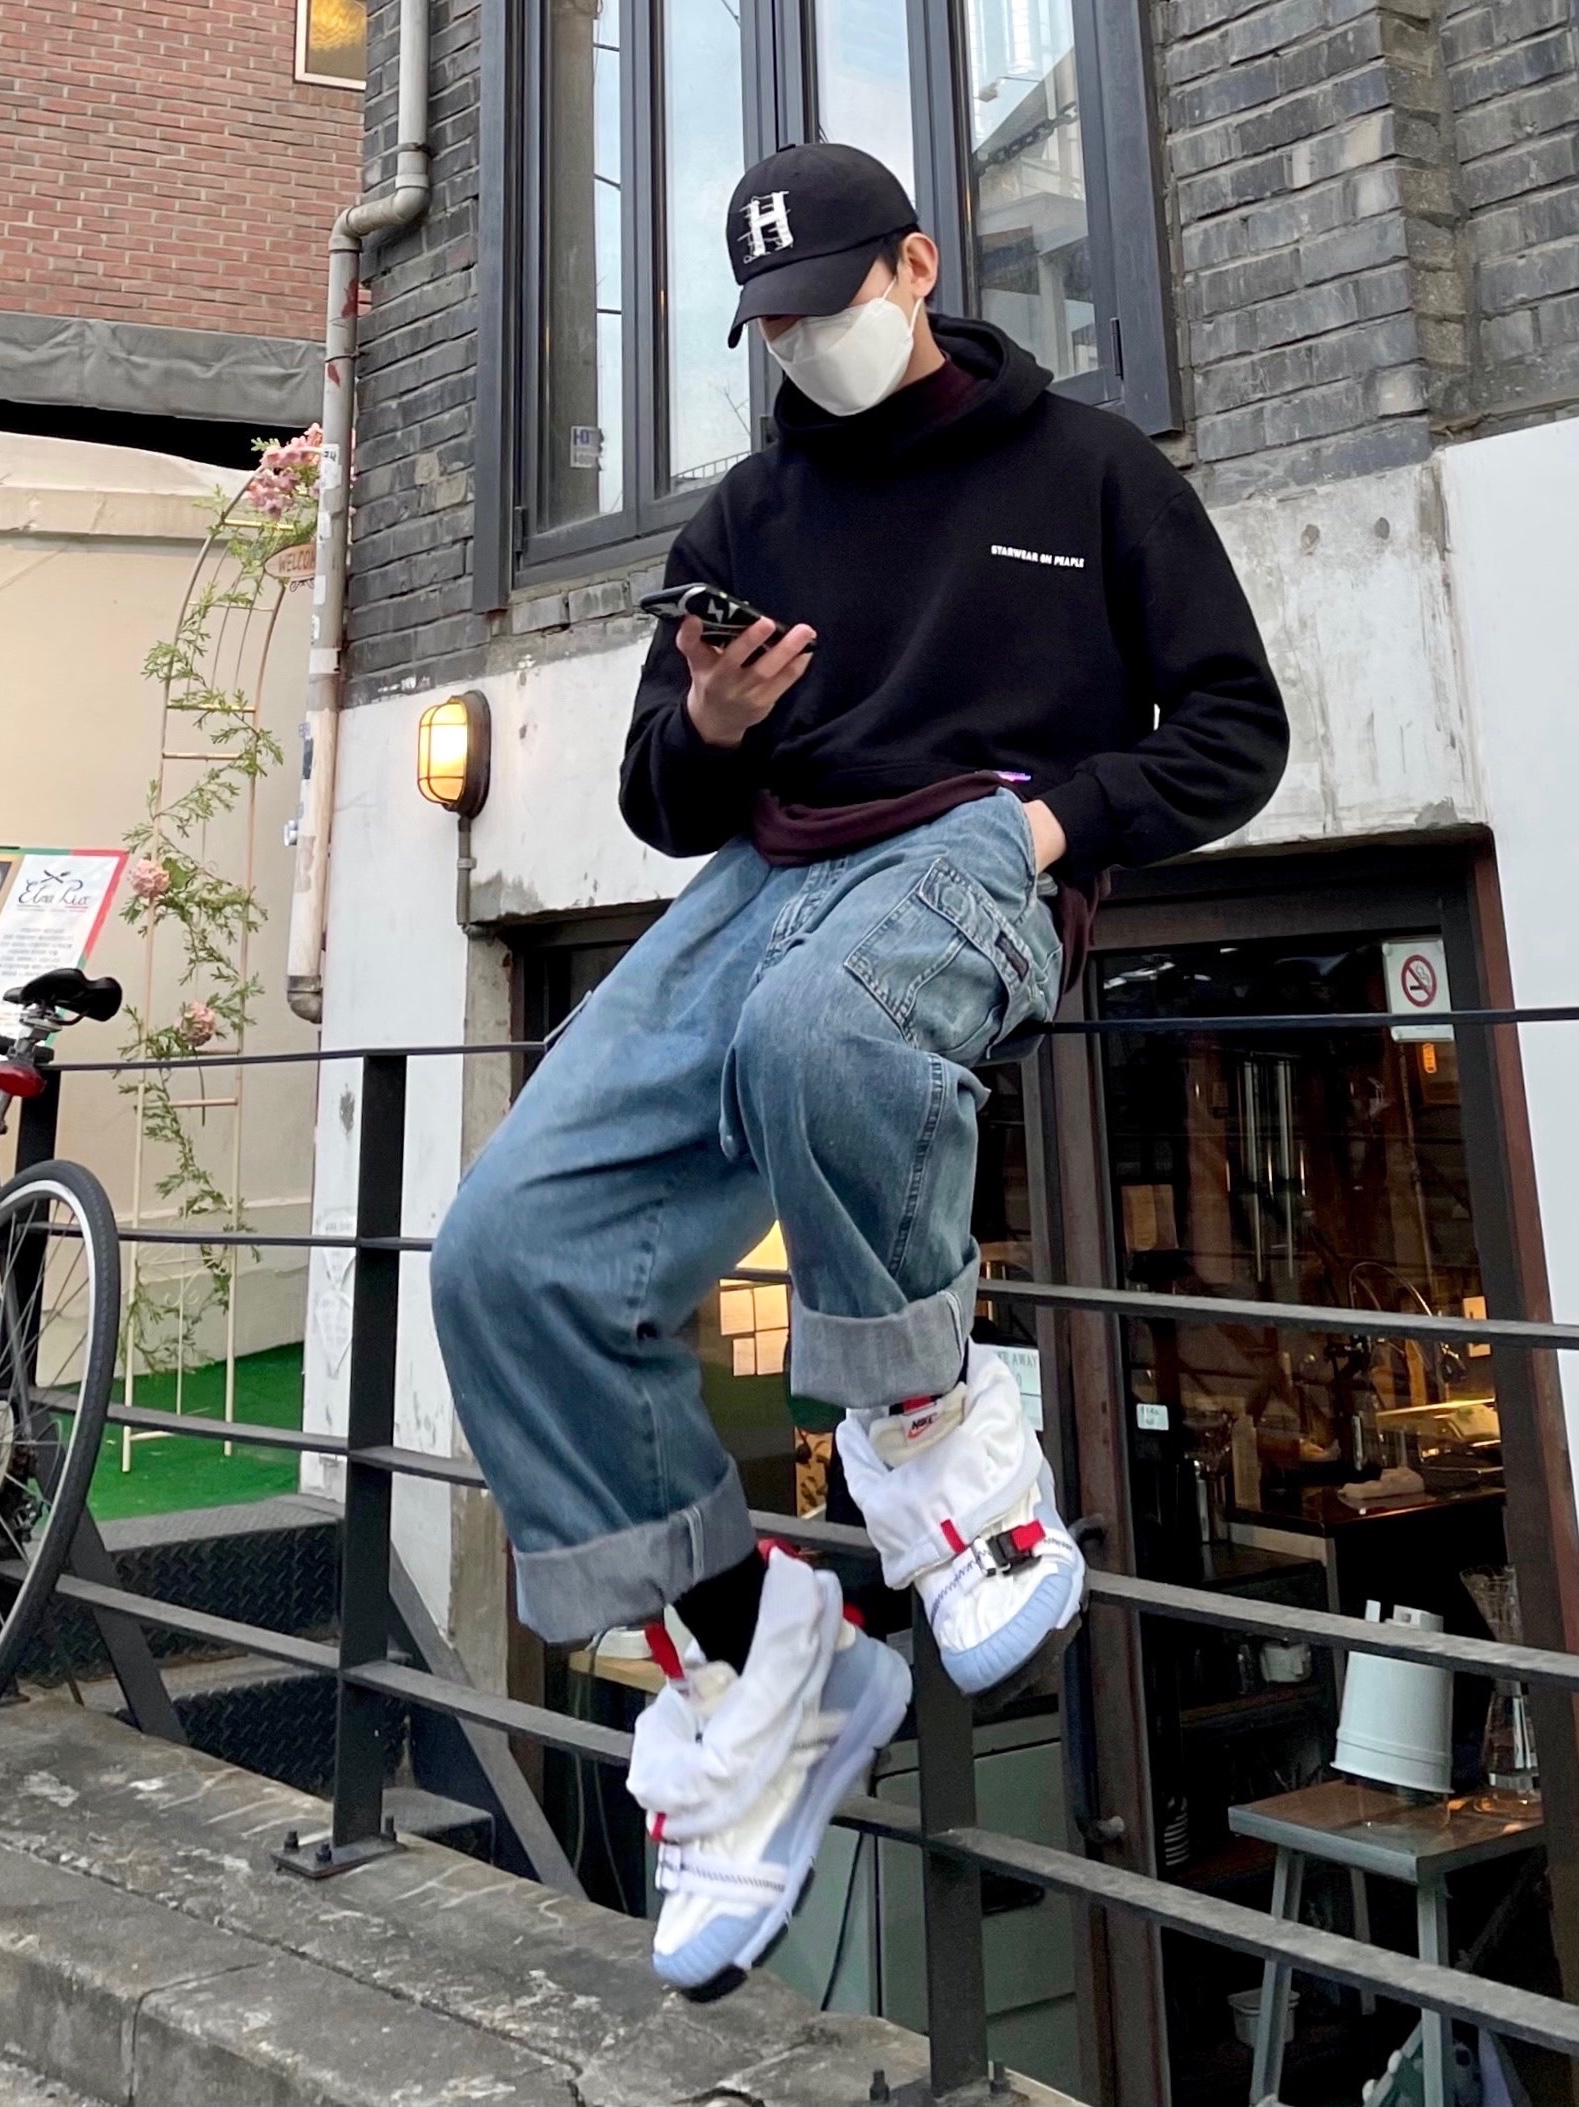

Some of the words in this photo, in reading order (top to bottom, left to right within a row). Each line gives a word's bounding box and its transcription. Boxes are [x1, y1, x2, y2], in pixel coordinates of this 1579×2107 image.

[737, 190, 794, 264] H
[1012, 1352, 1038, 1368] AWAY
[911, 1413, 935, 1430] NIKE
